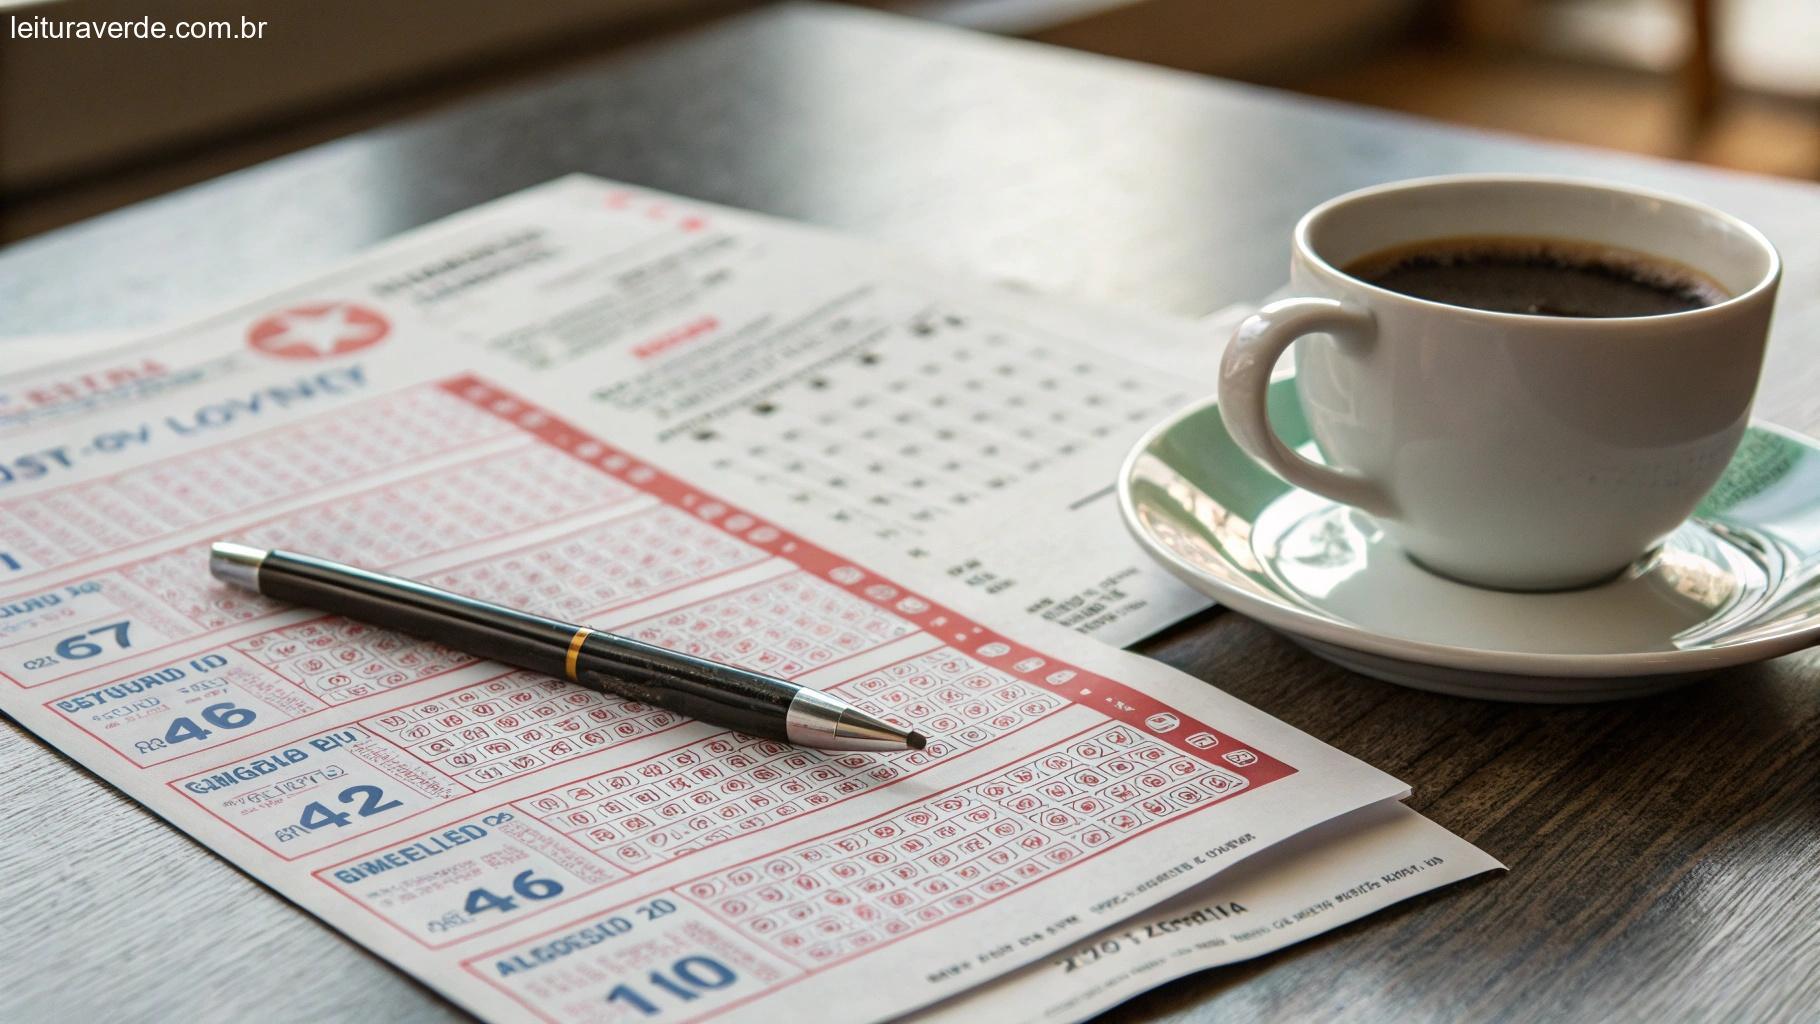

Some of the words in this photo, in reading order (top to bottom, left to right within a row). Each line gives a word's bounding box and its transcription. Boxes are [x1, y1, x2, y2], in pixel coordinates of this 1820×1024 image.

[55, 620, 131, 660] 67
[164, 702, 256, 744] 46
[299, 784, 404, 831] 42
[464, 869, 565, 915] 46
